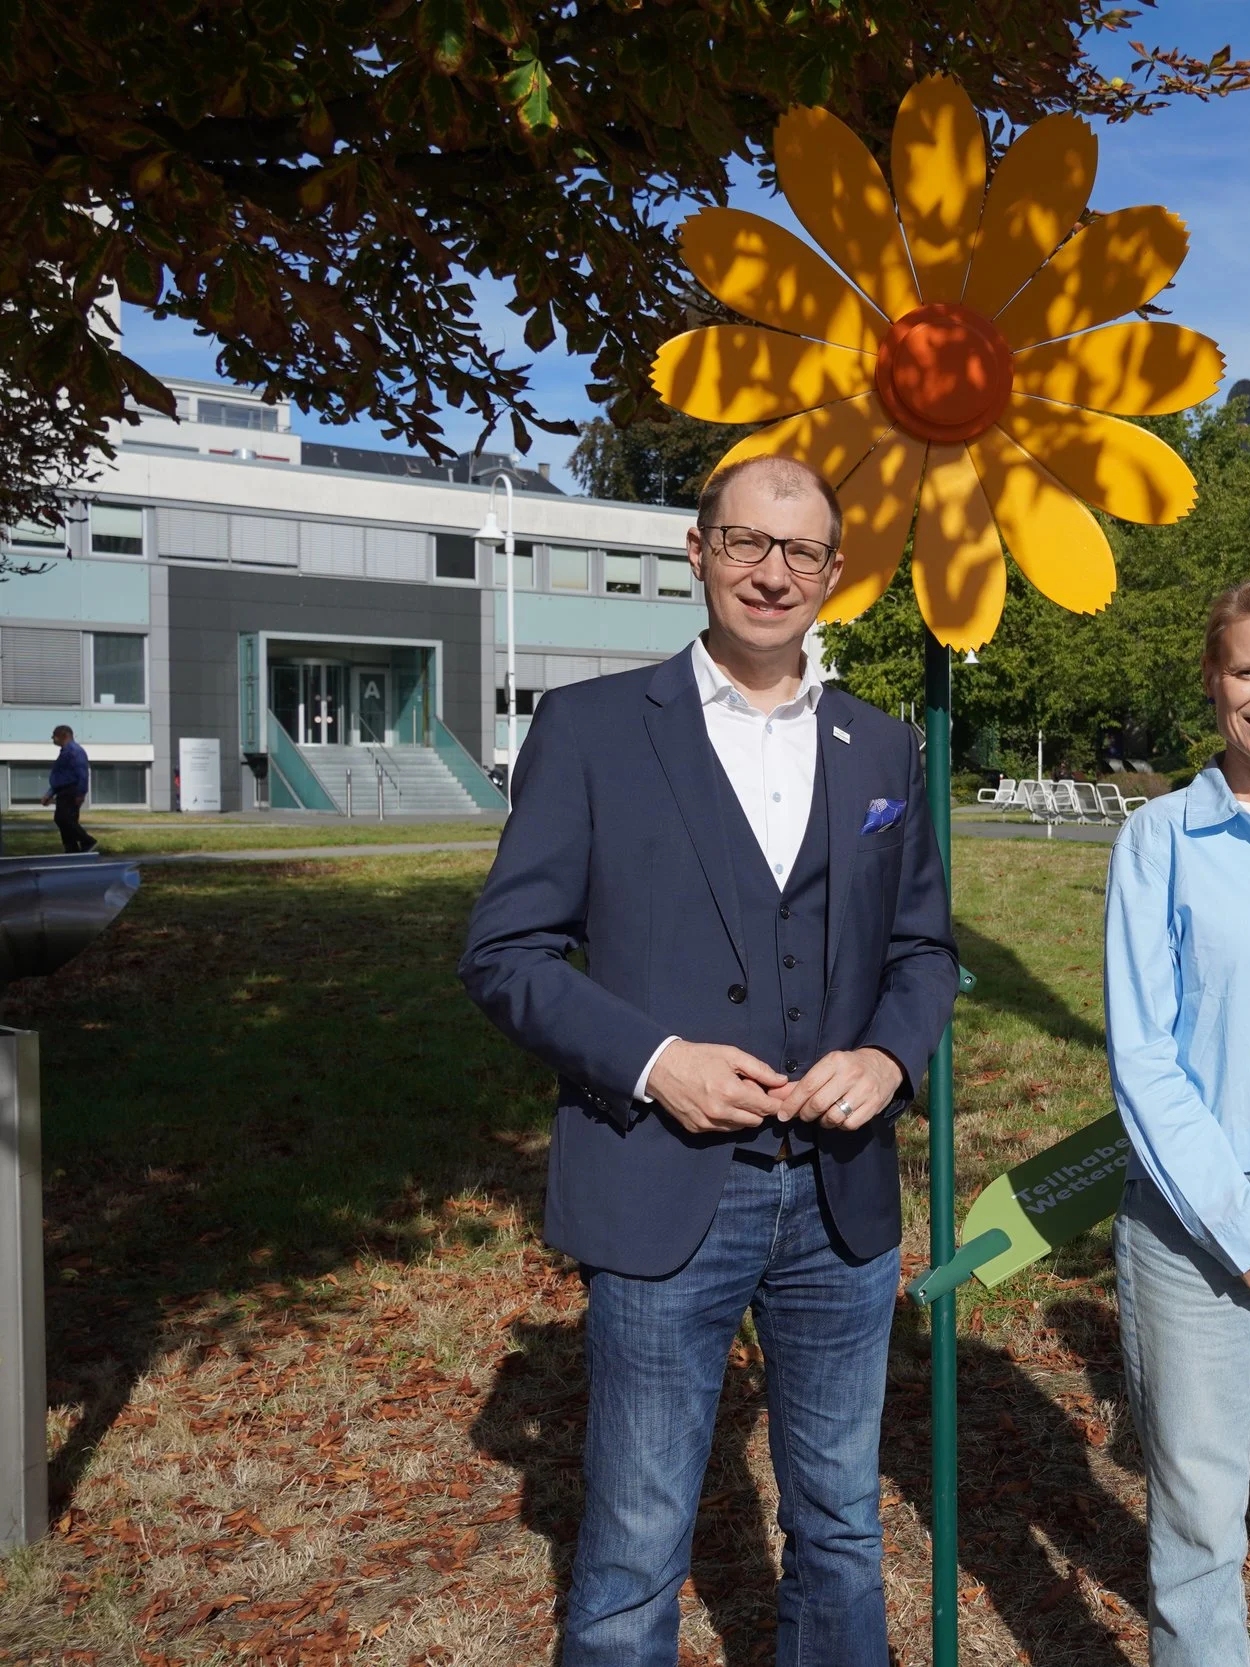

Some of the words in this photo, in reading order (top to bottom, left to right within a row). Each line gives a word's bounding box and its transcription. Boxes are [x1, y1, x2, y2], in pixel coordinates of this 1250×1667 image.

[364, 680, 381, 700] A
[1011, 1137, 1131, 1202] Teilhabe
[1025, 1153, 1130, 1214] Wettera
